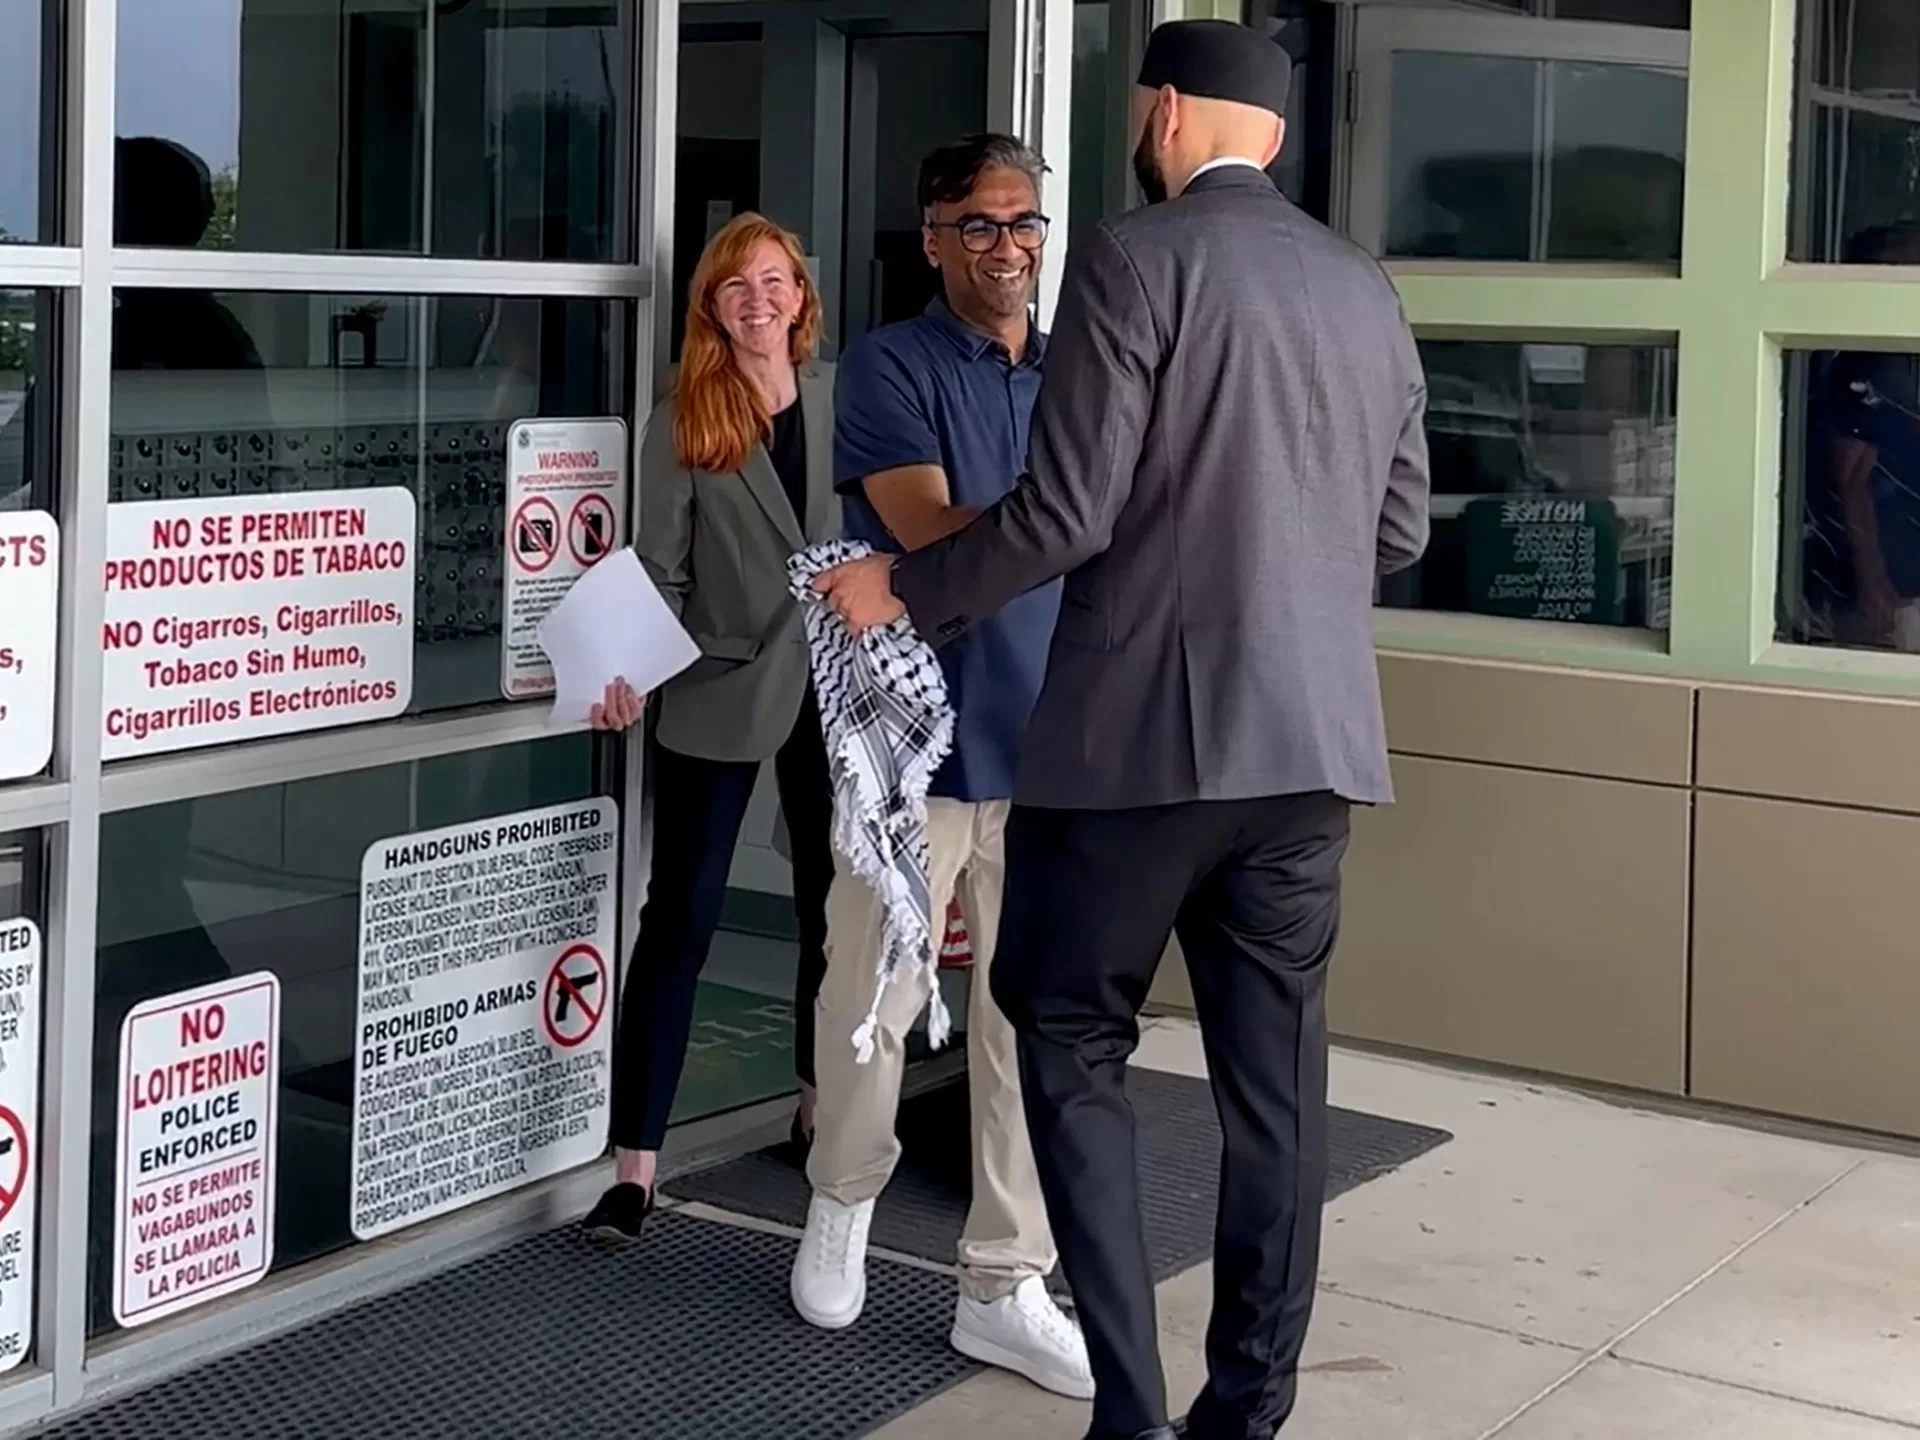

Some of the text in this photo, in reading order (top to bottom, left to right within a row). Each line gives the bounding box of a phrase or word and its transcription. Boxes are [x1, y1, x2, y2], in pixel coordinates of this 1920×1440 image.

[538, 450, 600, 470] WARNING
[153, 508, 366, 549] NO SE PERMITEN
[104, 541, 405, 591] PRODUCTOS DE TABACO
[103, 600, 403, 650] NO Cigarros, Cigarrillos,
[144, 643, 366, 688] Tobaco Sin Humo,
[106, 680, 397, 739] Cigarrillos Electrónicos
[384, 807, 600, 871] HANDGUNS PROHIBITED
[365, 897, 406, 922] LICENSE
[408, 888, 447, 913] HOLDER
[474, 881, 480, 898] A
[483, 868, 537, 896] CONCEALED
[366, 874, 416, 899] PURSUANT
[419, 870, 431, 887] TO
[435, 861, 474, 884] SECTION
[530, 844, 554, 864] CODE
[364, 928, 372, 946] A
[374, 918, 413, 943] PERSON
[415, 906, 462, 933] LICENSED
[465, 899, 495, 921] UNDER
[568, 872, 607, 896] CHAPTER
[362, 970, 382, 990] MAY
[385, 964, 405, 985] NOT
[408, 956, 440, 979] ENTER
[442, 950, 462, 970] THIS
[464, 938, 512, 965] PROPERTY
[546, 917, 596, 944] CONCEALED
[384, 931, 449, 964] GOVERNMENT
[452, 924, 479, 947] CODE
[16, 963, 34, 987] BY
[180, 1004, 225, 1047] NO
[363, 978, 536, 1046] PROHIBIDO ARMAS
[362, 1023, 457, 1071] DE FUEGO
[132, 1041, 266, 1110] LOITERING
[360, 1075, 373, 1094] DE
[374, 1061, 420, 1090] ACUERDO
[422, 1055, 442, 1076] CON
[444, 1051, 456, 1070] LA
[460, 1080, 499, 1107] LICENCIA
[501, 1075, 518, 1095] CON
[160, 1091, 240, 1134] POLICE
[379, 1126, 423, 1155] PERSONA
[425, 1119, 445, 1140] CON
[447, 1106, 487, 1134] LICENCIA
[139, 1119, 257, 1173] ENFORCED
[132, 1159, 261, 1217] NO SE PERMITE
[383, 1170, 421, 1198] PORTAR
[138, 1190, 254, 1243] VAGABUNDOS
[355, 1196, 408, 1230] PROPIEDAD
[411, 1189, 431, 1211] CON
[133, 1217, 256, 1274] SE LLAMARA A
[148, 1250, 241, 1298] LA POLICIA
